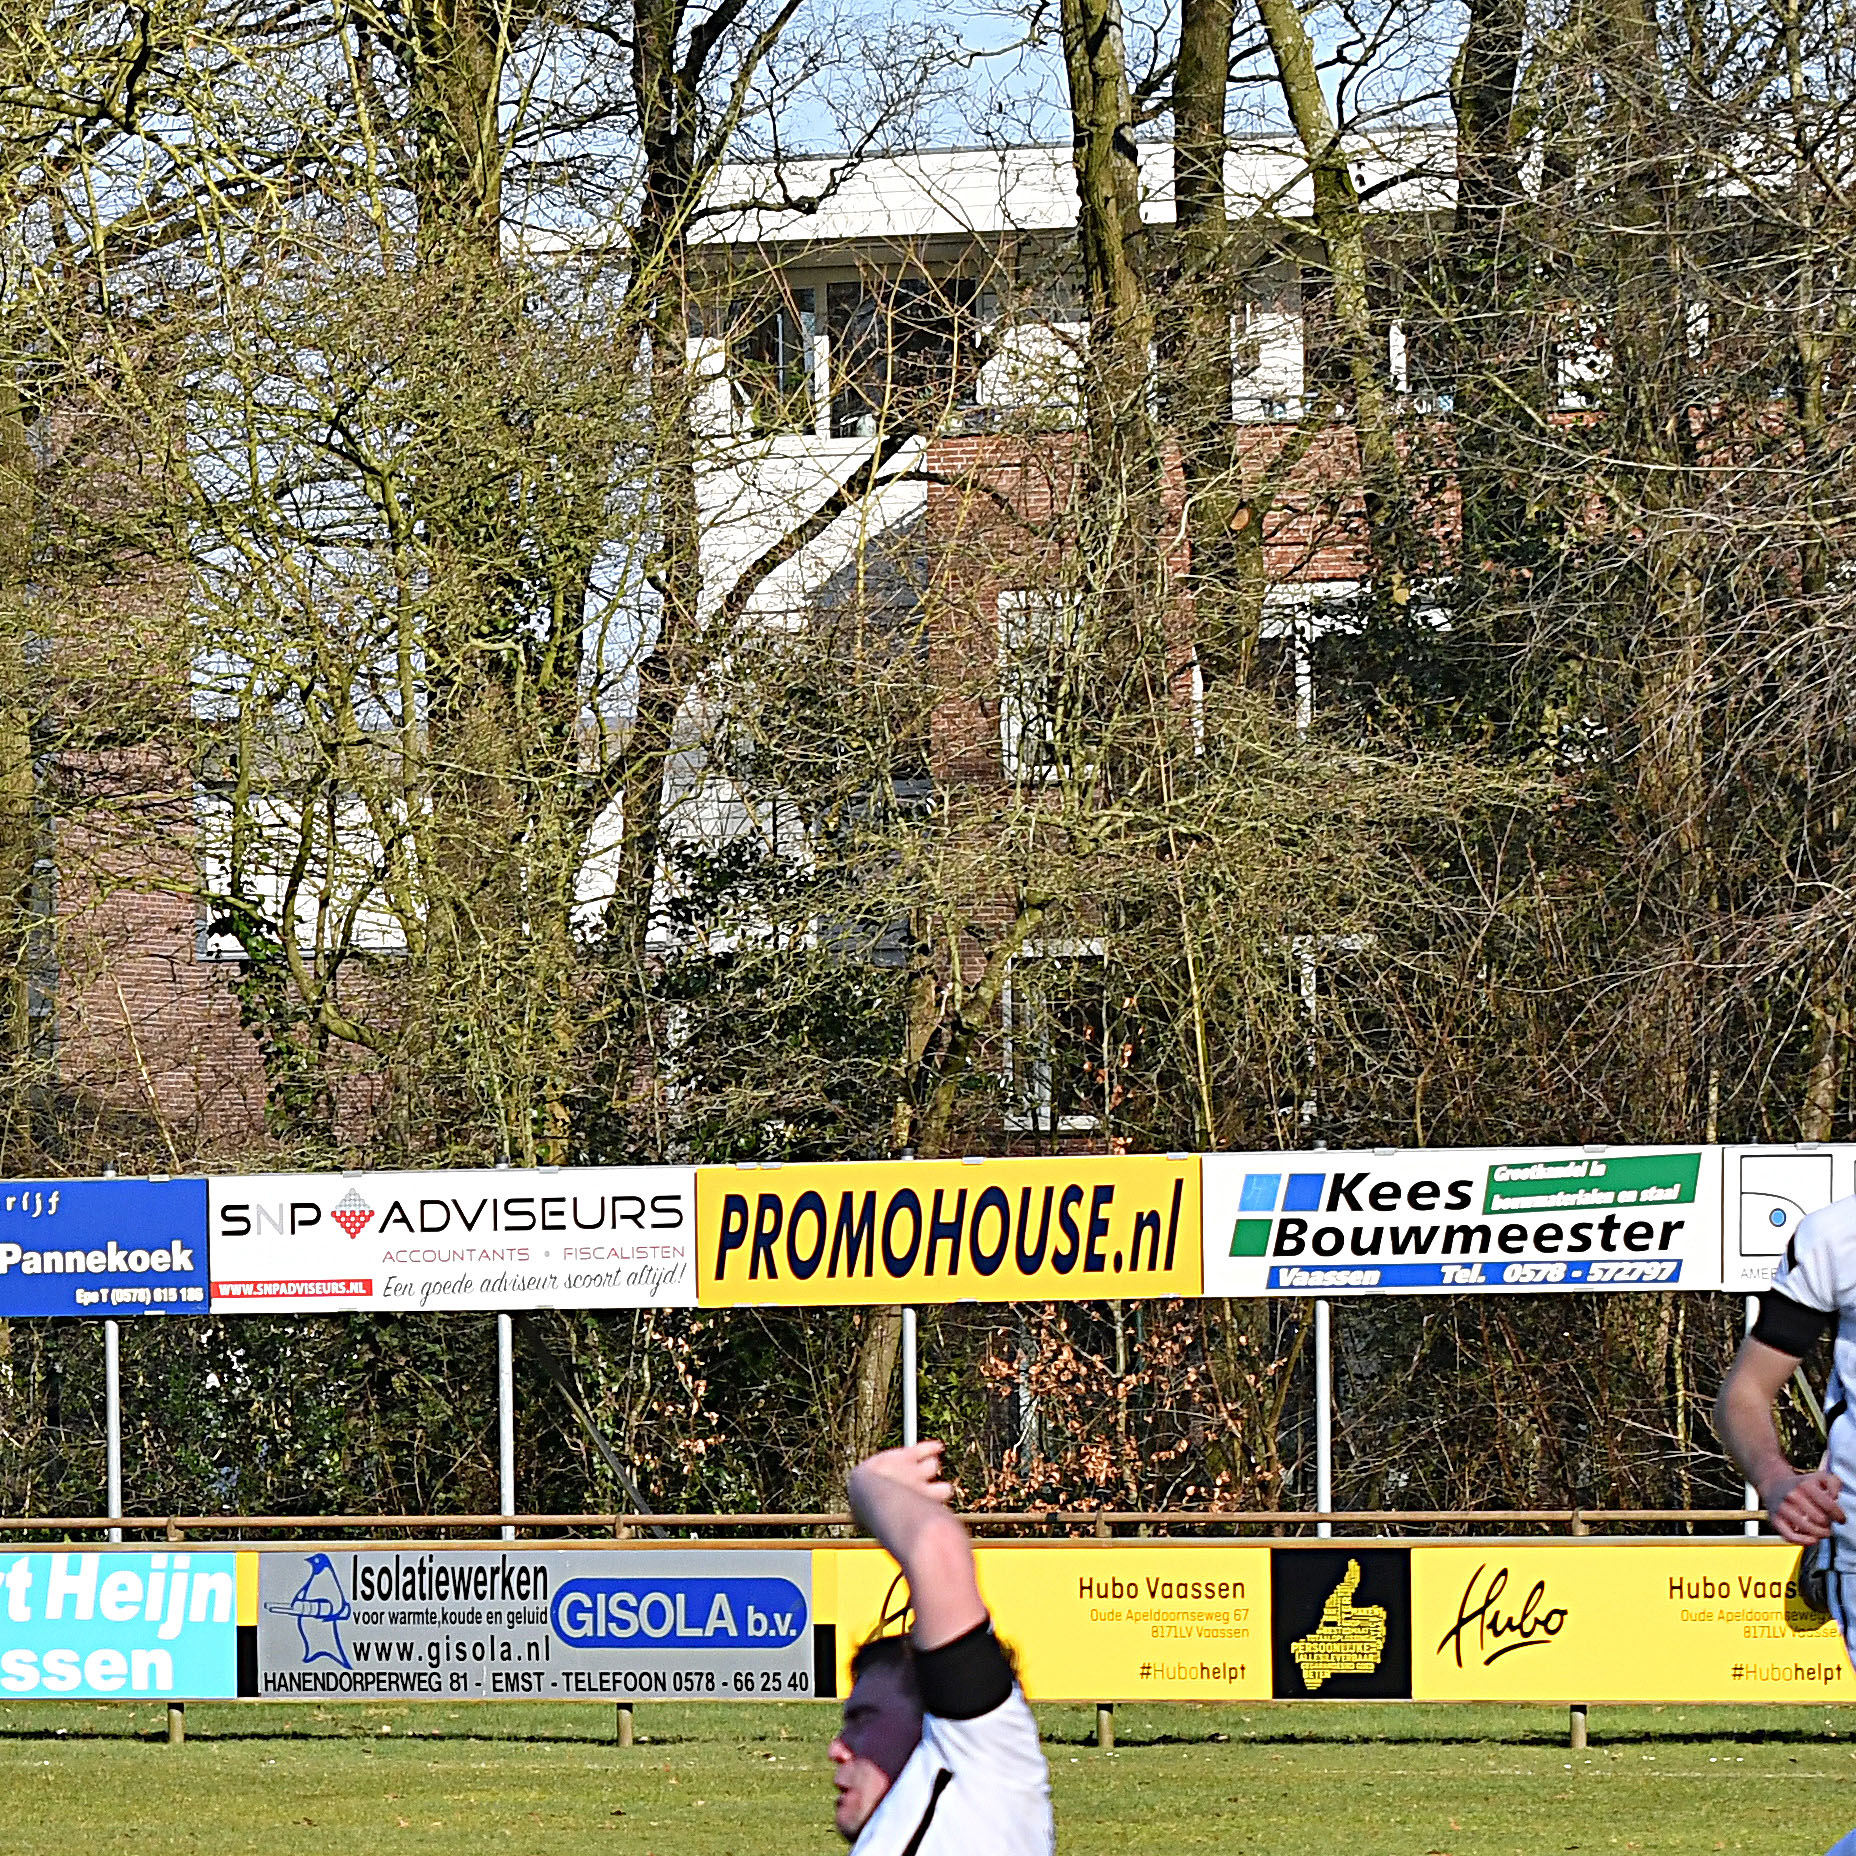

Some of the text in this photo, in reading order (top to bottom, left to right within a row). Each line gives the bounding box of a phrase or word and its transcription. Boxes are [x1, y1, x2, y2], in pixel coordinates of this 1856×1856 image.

[1324, 1171, 1474, 1213] Kees
[220, 1194, 684, 1237] SNP ADVISEURS
[714, 1177, 1185, 1282] PROMOHOUSE.nl
[1272, 1214, 1686, 1258] Bouwmeester
[382, 1245, 685, 1264] ACCOUNTANTS FISCALISTEN
[479, 1270, 559, 1294] adviseur
[1277, 1266, 1382, 1288] Vaassen
[1440, 1263, 1487, 1285] Tel.
[1501, 1261, 1567, 1284] 0578
[218, 1280, 367, 1297] WWW.SNPADVISEURS.NL
[351, 1553, 549, 1602] Isolatiewerken
[1078, 1576, 1246, 1600] Hubo Vaassen
[1668, 1575, 1797, 1600] Hubo Vaas
[45, 1552, 234, 1641] Heijn
[352, 1610, 386, 1627] voor
[486, 1610, 504, 1626] en
[506, 1606, 549, 1631] geluid
[557, 1591, 799, 1639] GISOLA b.v.
[1090, 1607, 1250, 1625] Oude Apeldoornseweg 67
[1436, 1562, 1569, 1668] Hubo
[1680, 1608, 1714, 1623] Oude
[1150, 1625, 1250, 1639] 8171LV Vaassen
[1742, 1624, 1788, 1639] 8171LV
[263, 1670, 443, 1693] HANENDORPERWEG
[448, 1671, 469, 1693] 81
[491, 1670, 545, 1693] EMST
[560, 1670, 669, 1693] TELEFOON
[672, 1670, 716, 1693] 0578
[732, 1670, 757, 1693] 66
[759, 1670, 784, 1693] 25
[785, 1670, 810, 1693] 40
[1139, 1662, 1247, 1685] #Hubohelpt
[1731, 1662, 1843, 1685] #Hubohelpt
